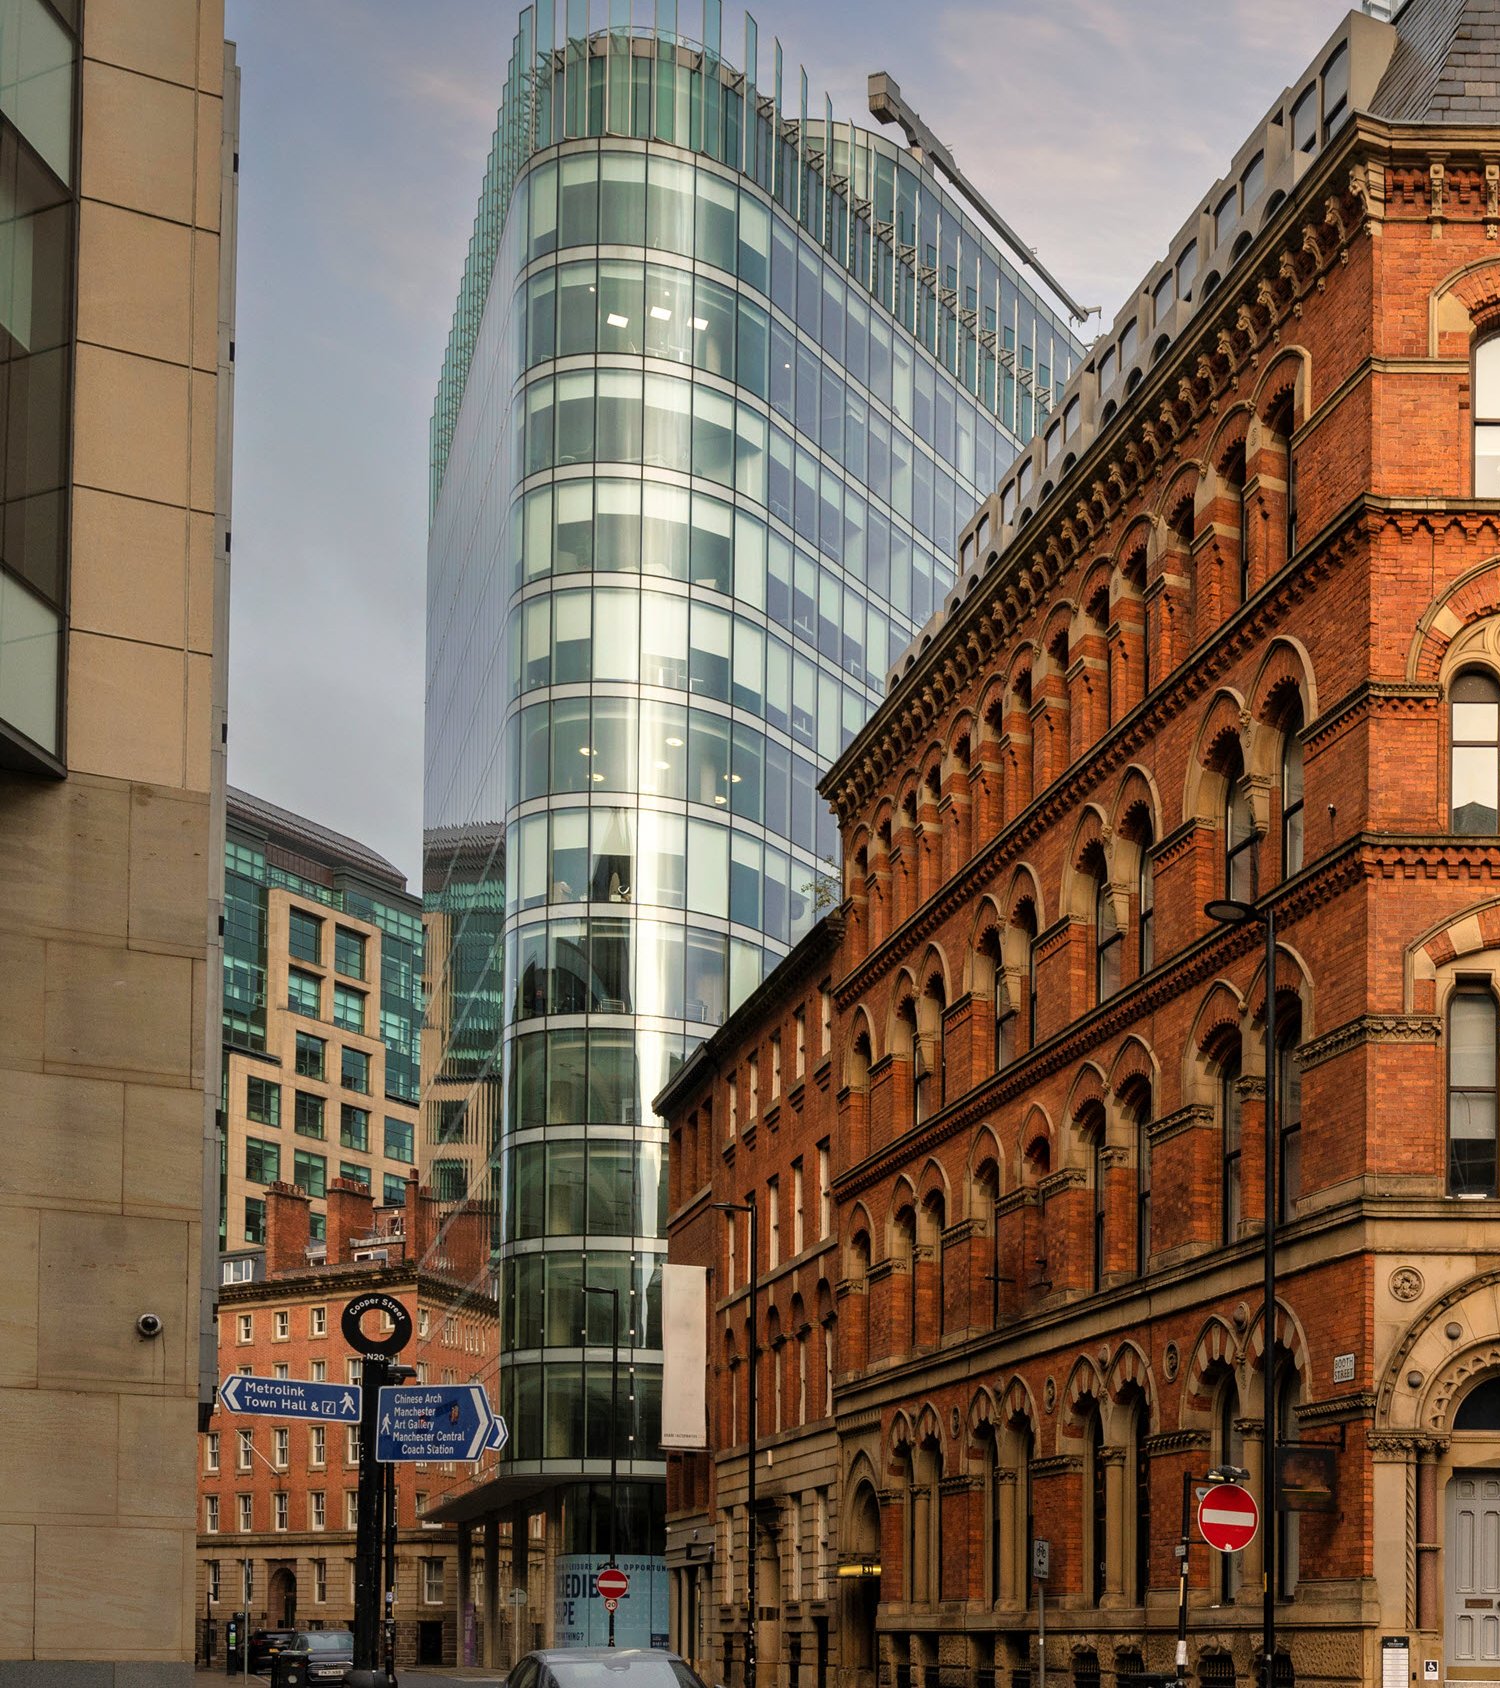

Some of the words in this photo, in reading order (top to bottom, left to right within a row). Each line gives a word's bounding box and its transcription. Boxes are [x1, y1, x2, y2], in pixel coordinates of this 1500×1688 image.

[349, 1298, 379, 1315] Cooper
[381, 1298, 406, 1321] Street
[366, 1353, 385, 1361] N20
[1335, 1356, 1354, 1369] BOOTH
[1335, 1368, 1354, 1381] STREET
[245, 1382, 305, 1397] Metrolink
[244, 1396, 277, 1409] Town
[281, 1399, 307, 1411] Hall
[311, 1402, 319, 1412] &
[394, 1394, 423, 1404] Chinese
[425, 1393, 442, 1404] Arch
[394, 1407, 436, 1417] Manchester
[394, 1420, 406, 1430] Art
[407, 1419, 435, 1431] Gallery
[393, 1432, 434, 1442] Manchester
[436, 1431, 465, 1442] Central
[401, 1444, 425, 1455] Coach
[426, 1444, 454, 1455] Station
[863, 1566, 872, 1574] 31
